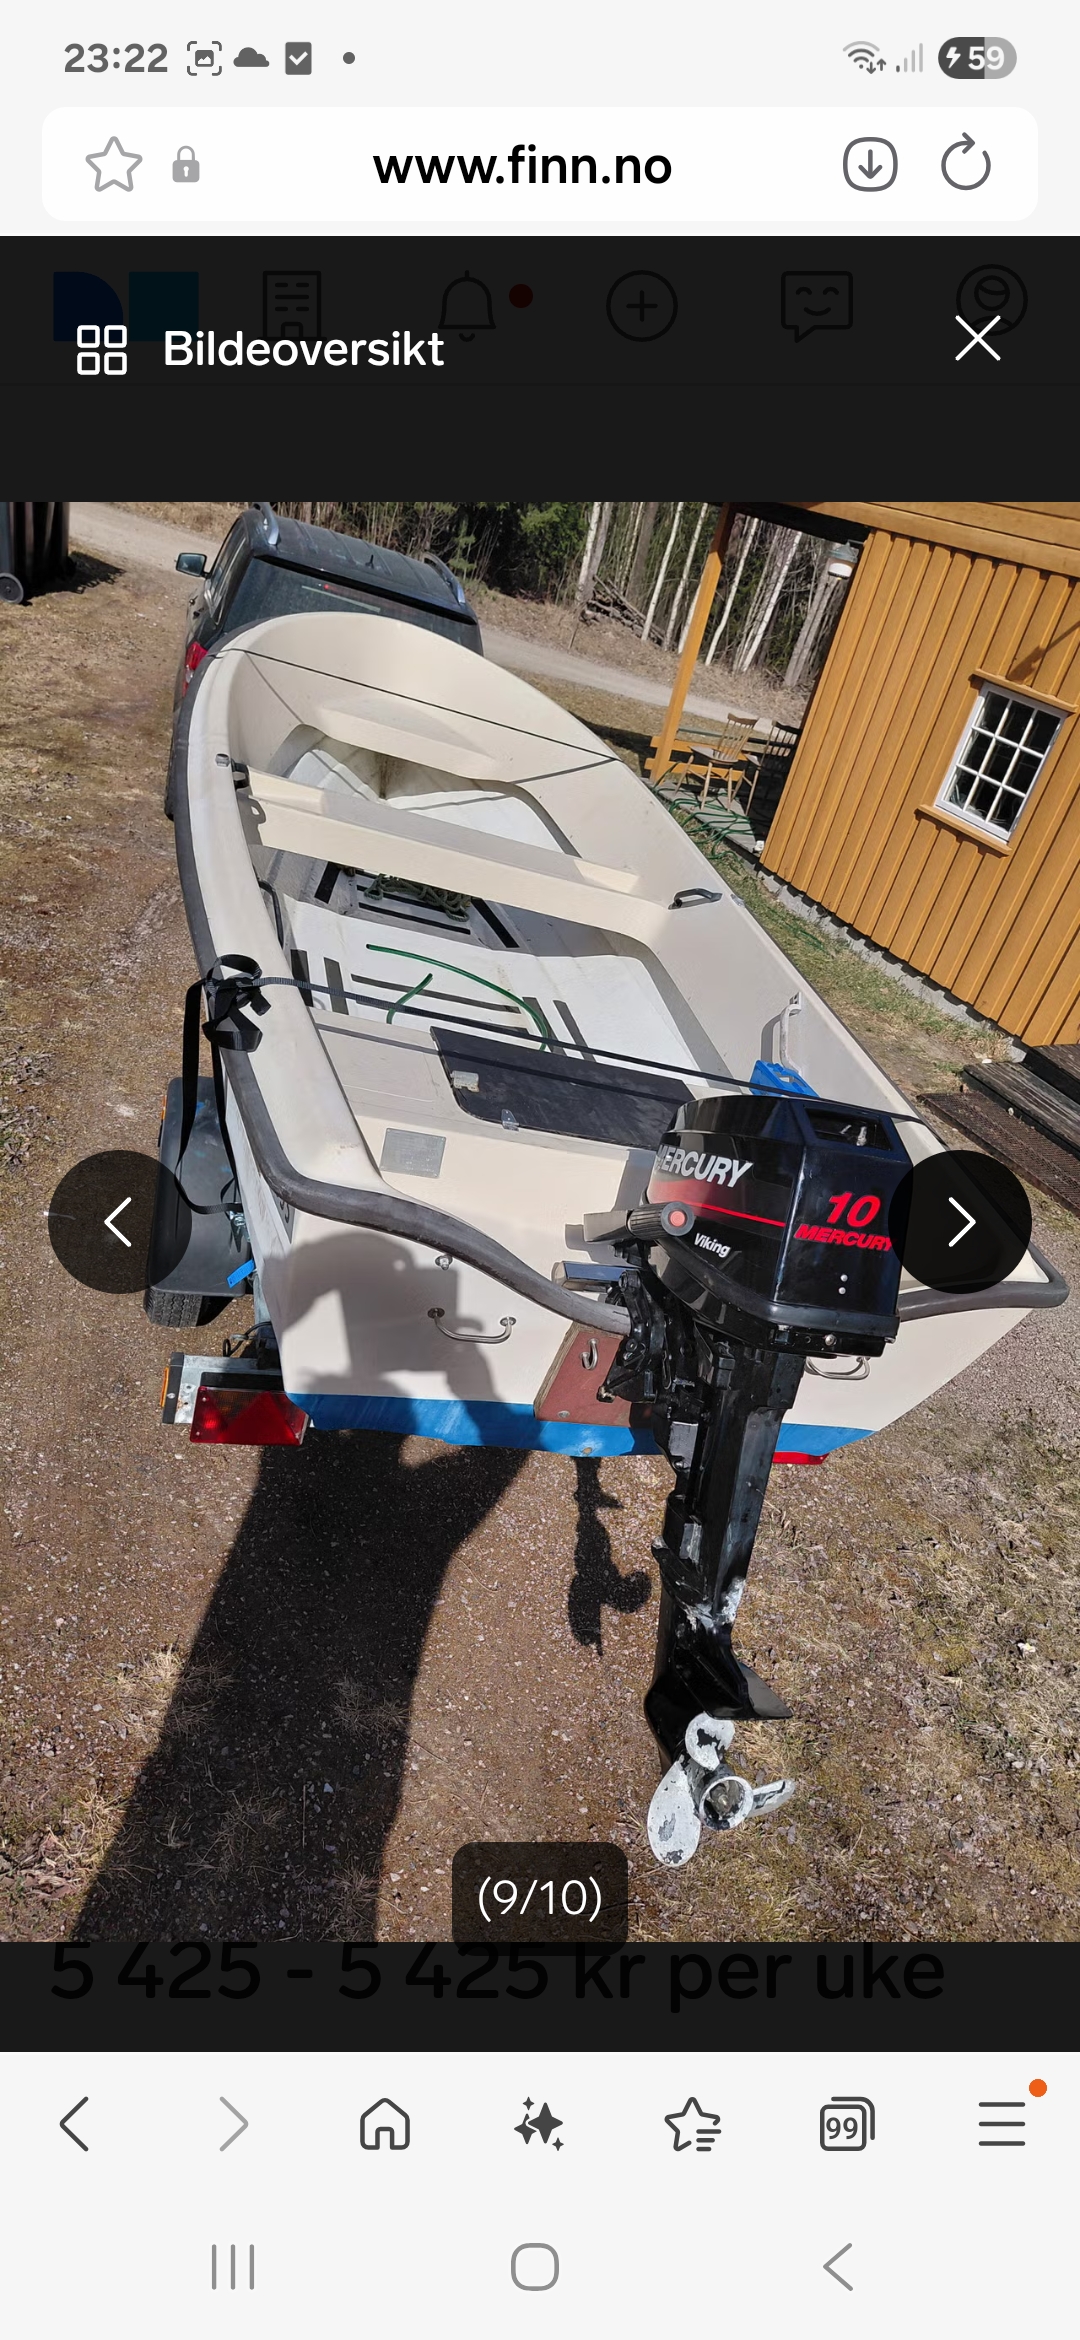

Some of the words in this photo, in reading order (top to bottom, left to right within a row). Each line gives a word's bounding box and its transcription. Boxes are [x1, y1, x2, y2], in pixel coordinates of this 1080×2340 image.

[65, 43, 168, 73] 23:22
[968, 46, 1005, 70] 59
[373, 144, 672, 184] www.finn.no
[164, 331, 445, 366] Bildeoversikt
[827, 1191, 882, 1228] 10
[694, 1232, 731, 1258] Viking
[479, 1877, 601, 1922] (9/10)
[51, 1942, 93, 1999] 5
[118, 1942, 260, 1999] 425
[287, 1969, 313, 1979] -
[339, 1942, 381, 1999] 5
[406, 1942, 549, 1999] 425
[576, 1942, 645, 1999] kr
[671, 1954, 793, 2013] per
[817, 1942, 944, 1999] uke
[825, 2116, 858, 2140] 99
